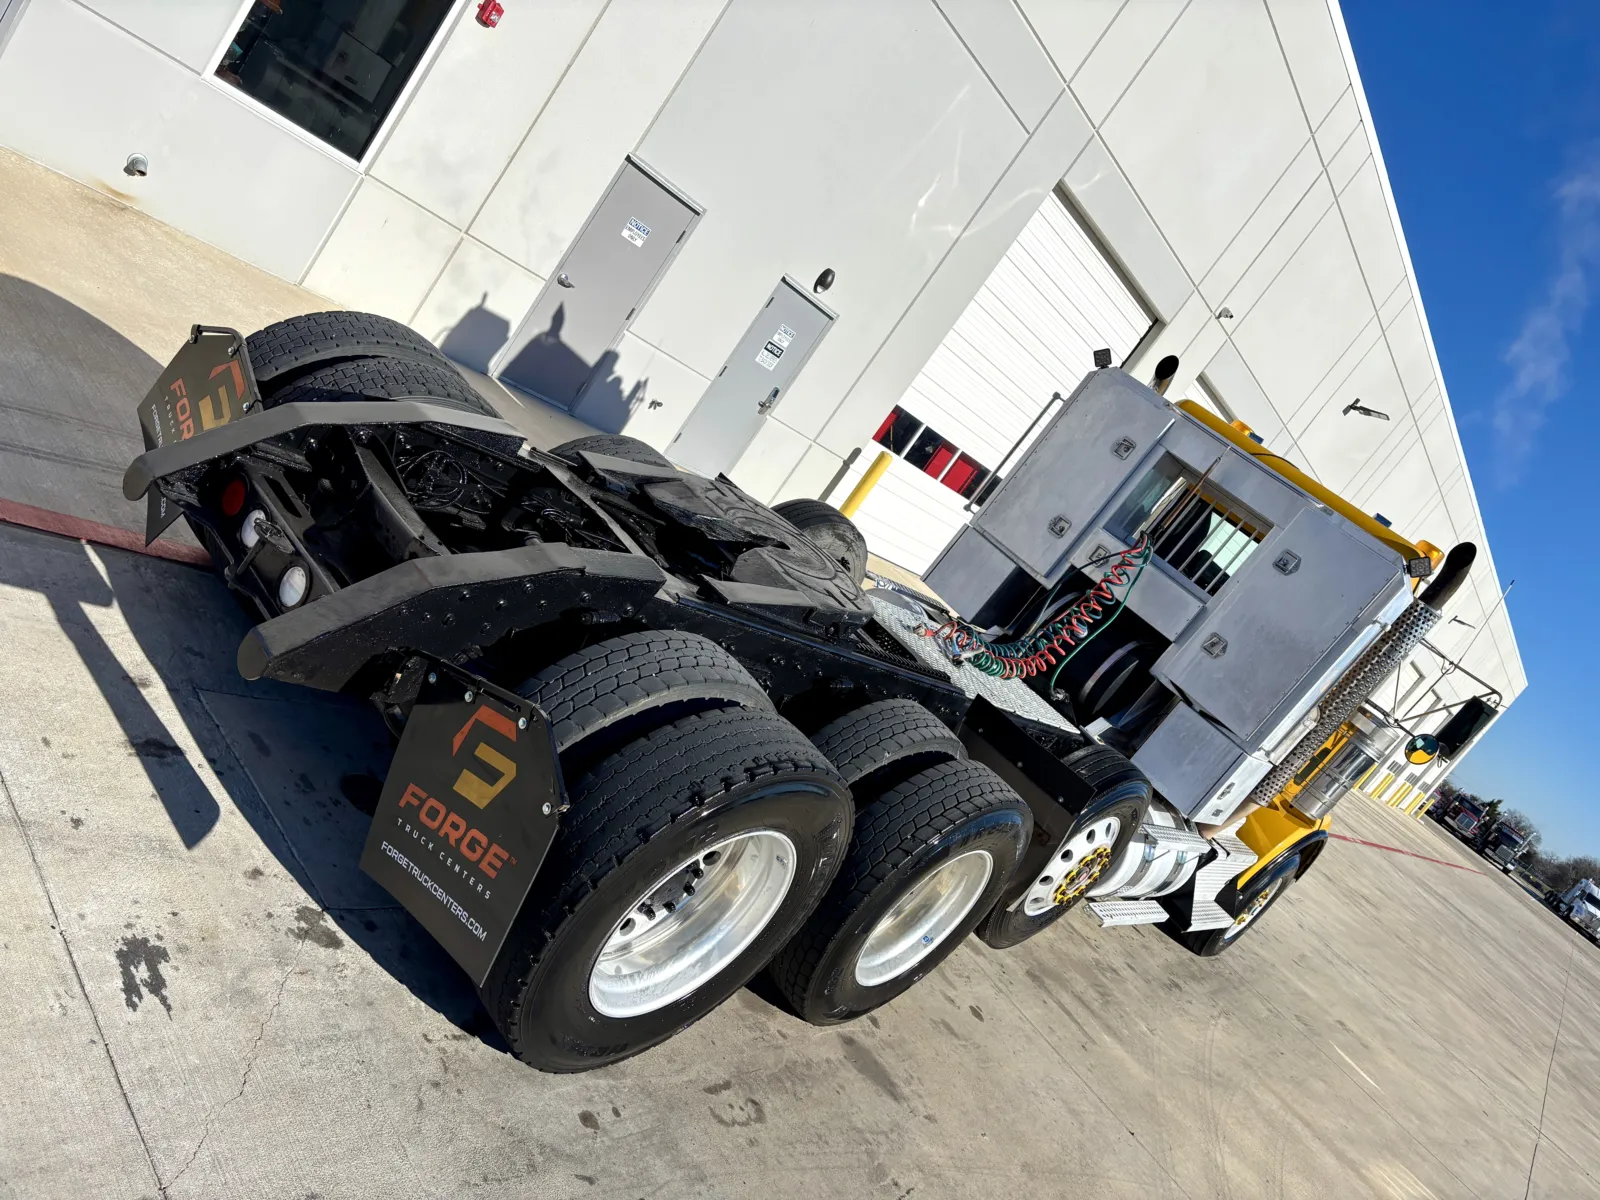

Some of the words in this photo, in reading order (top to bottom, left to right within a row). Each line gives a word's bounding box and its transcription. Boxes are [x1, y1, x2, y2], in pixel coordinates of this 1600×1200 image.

[629, 217, 650, 236] NOTICE
[765, 342, 784, 358] NOTICE
[170, 377, 195, 440] FOR
[397, 817, 435, 851] TRUCK
[439, 851, 491, 900] CENTERS
[398, 782, 510, 880] FORGE
[381, 840, 488, 942] FORGETRUCKCENTERS.COM
